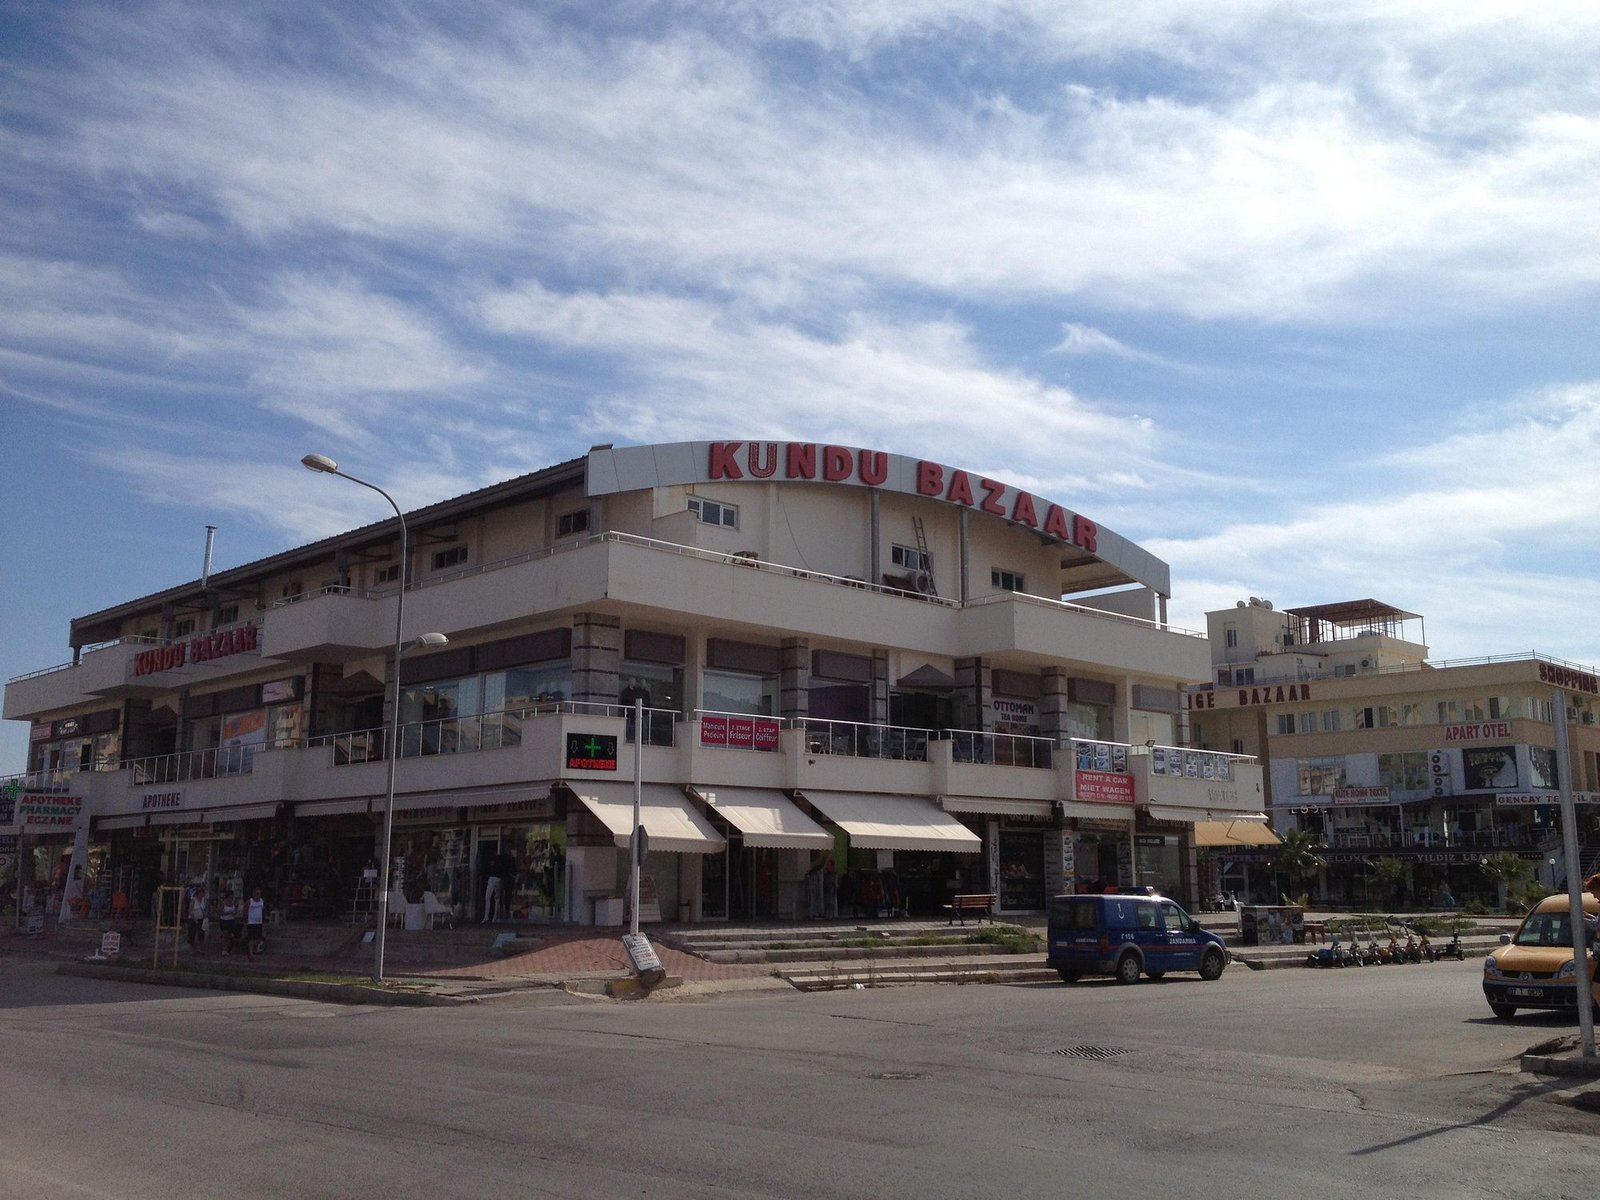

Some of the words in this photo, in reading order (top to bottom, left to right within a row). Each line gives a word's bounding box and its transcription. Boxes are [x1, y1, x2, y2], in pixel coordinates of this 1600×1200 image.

[709, 442, 888, 485] KUNDU
[917, 460, 1097, 552] BAZAAR
[134, 642, 186, 677] KUNDU
[191, 624, 257, 664] BAZAAR
[1540, 663, 1598, 694] SHOPPING
[1239, 684, 1310, 706] BAZAAR
[993, 700, 1034, 714] OTTOMAN
[1445, 725, 1480, 741] APART
[1482, 723, 1510, 738] OTEL
[569, 758, 615, 769] APOTHEKE
[1082, 773, 1104, 782] RENT
[1112, 777, 1128, 785] CAR
[1102, 786, 1131, 794] WAGEN
[21, 795, 83, 805] APOTHEKE
[143, 792, 181, 808] APOTHEKE
[19, 805, 82, 815] PHARMACY
[26, 815, 73, 825] ECZANE
[1417, 854, 1456, 862] YILDIZ
